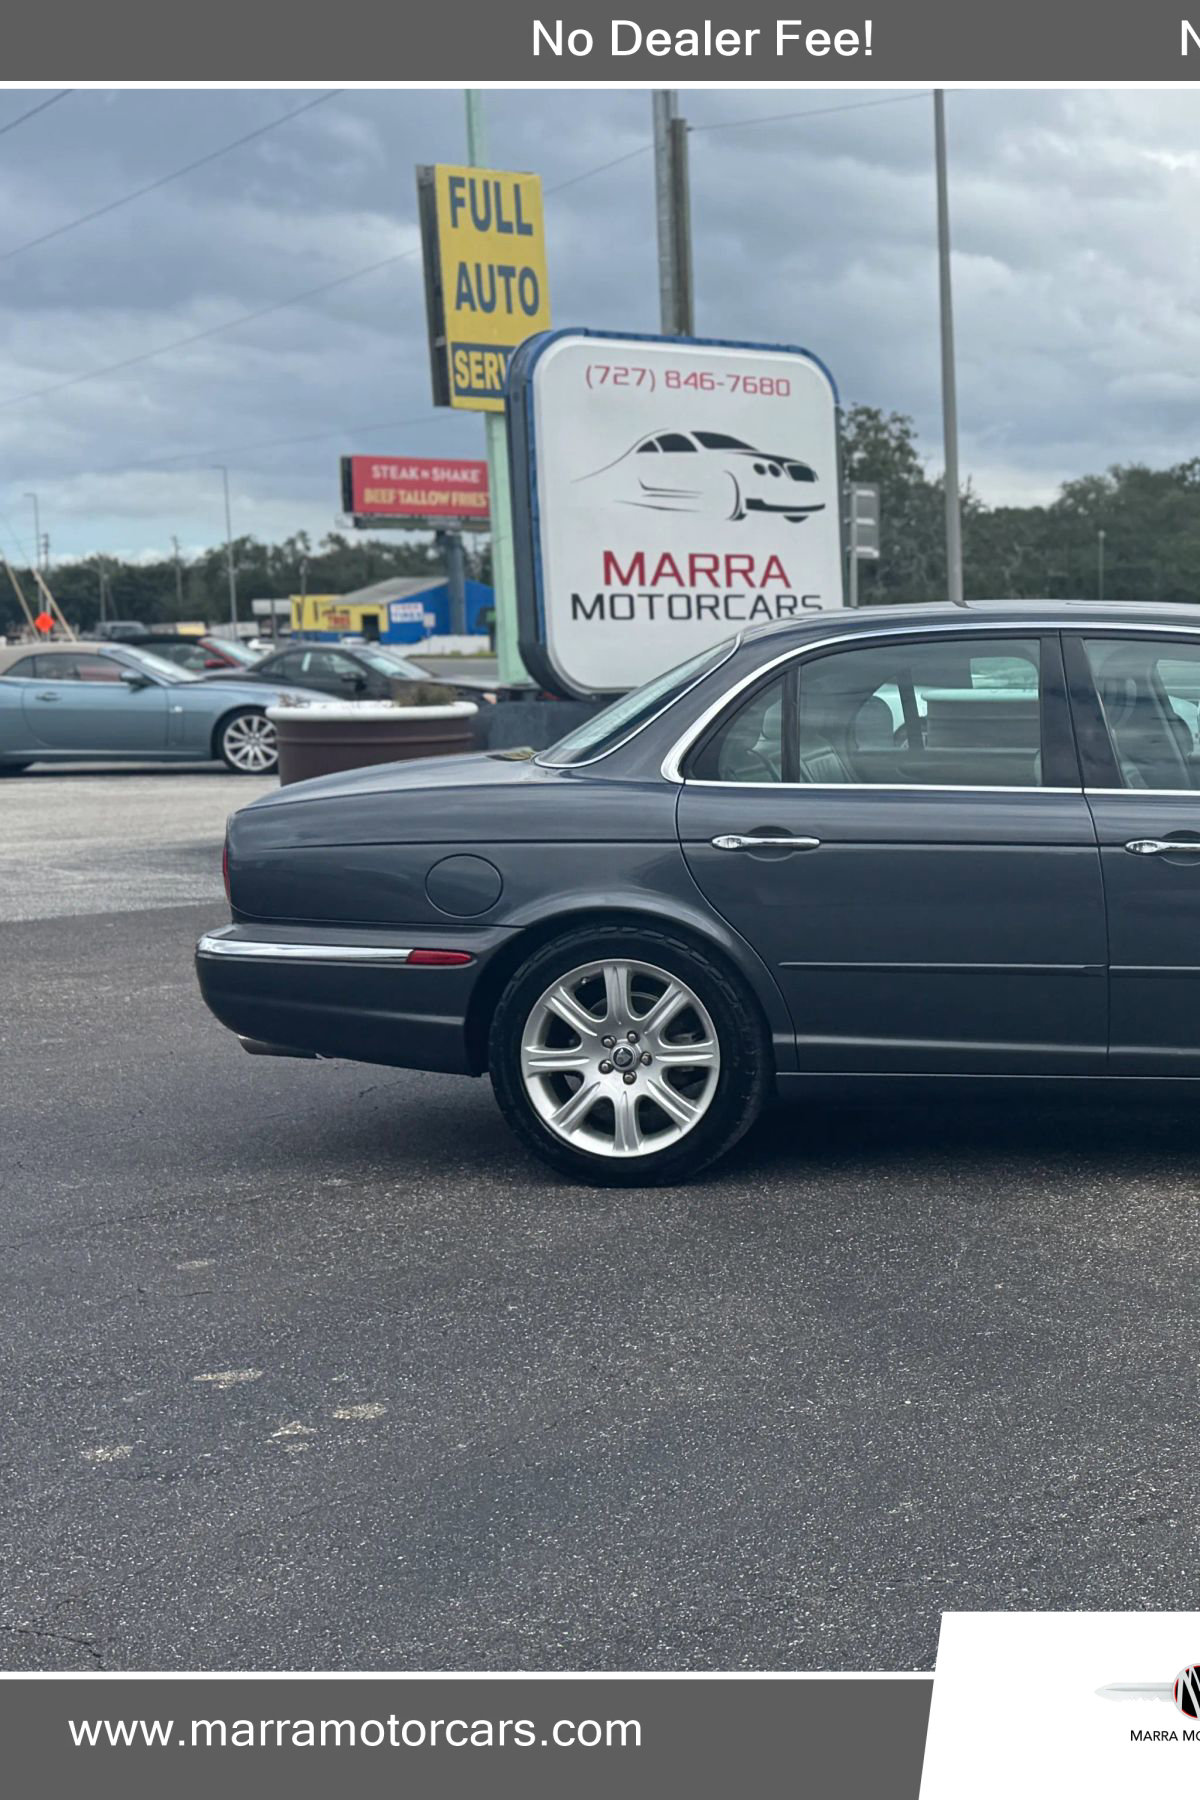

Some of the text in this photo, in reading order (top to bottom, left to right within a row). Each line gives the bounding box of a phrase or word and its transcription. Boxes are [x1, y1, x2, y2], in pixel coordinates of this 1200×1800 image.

[448, 175, 533, 236] FULL
[455, 261, 540, 317] AUTO
[585, 365, 791, 397] (727) 846-7680
[371, 464, 419, 480] STEAK
[431, 466, 480, 483] SHAKE
[363, 487, 397, 505] BEEF
[398, 489, 449, 507] TALLOW
[603, 550, 792, 588] MARRA
[571, 593, 823, 621] MOTORCARS
